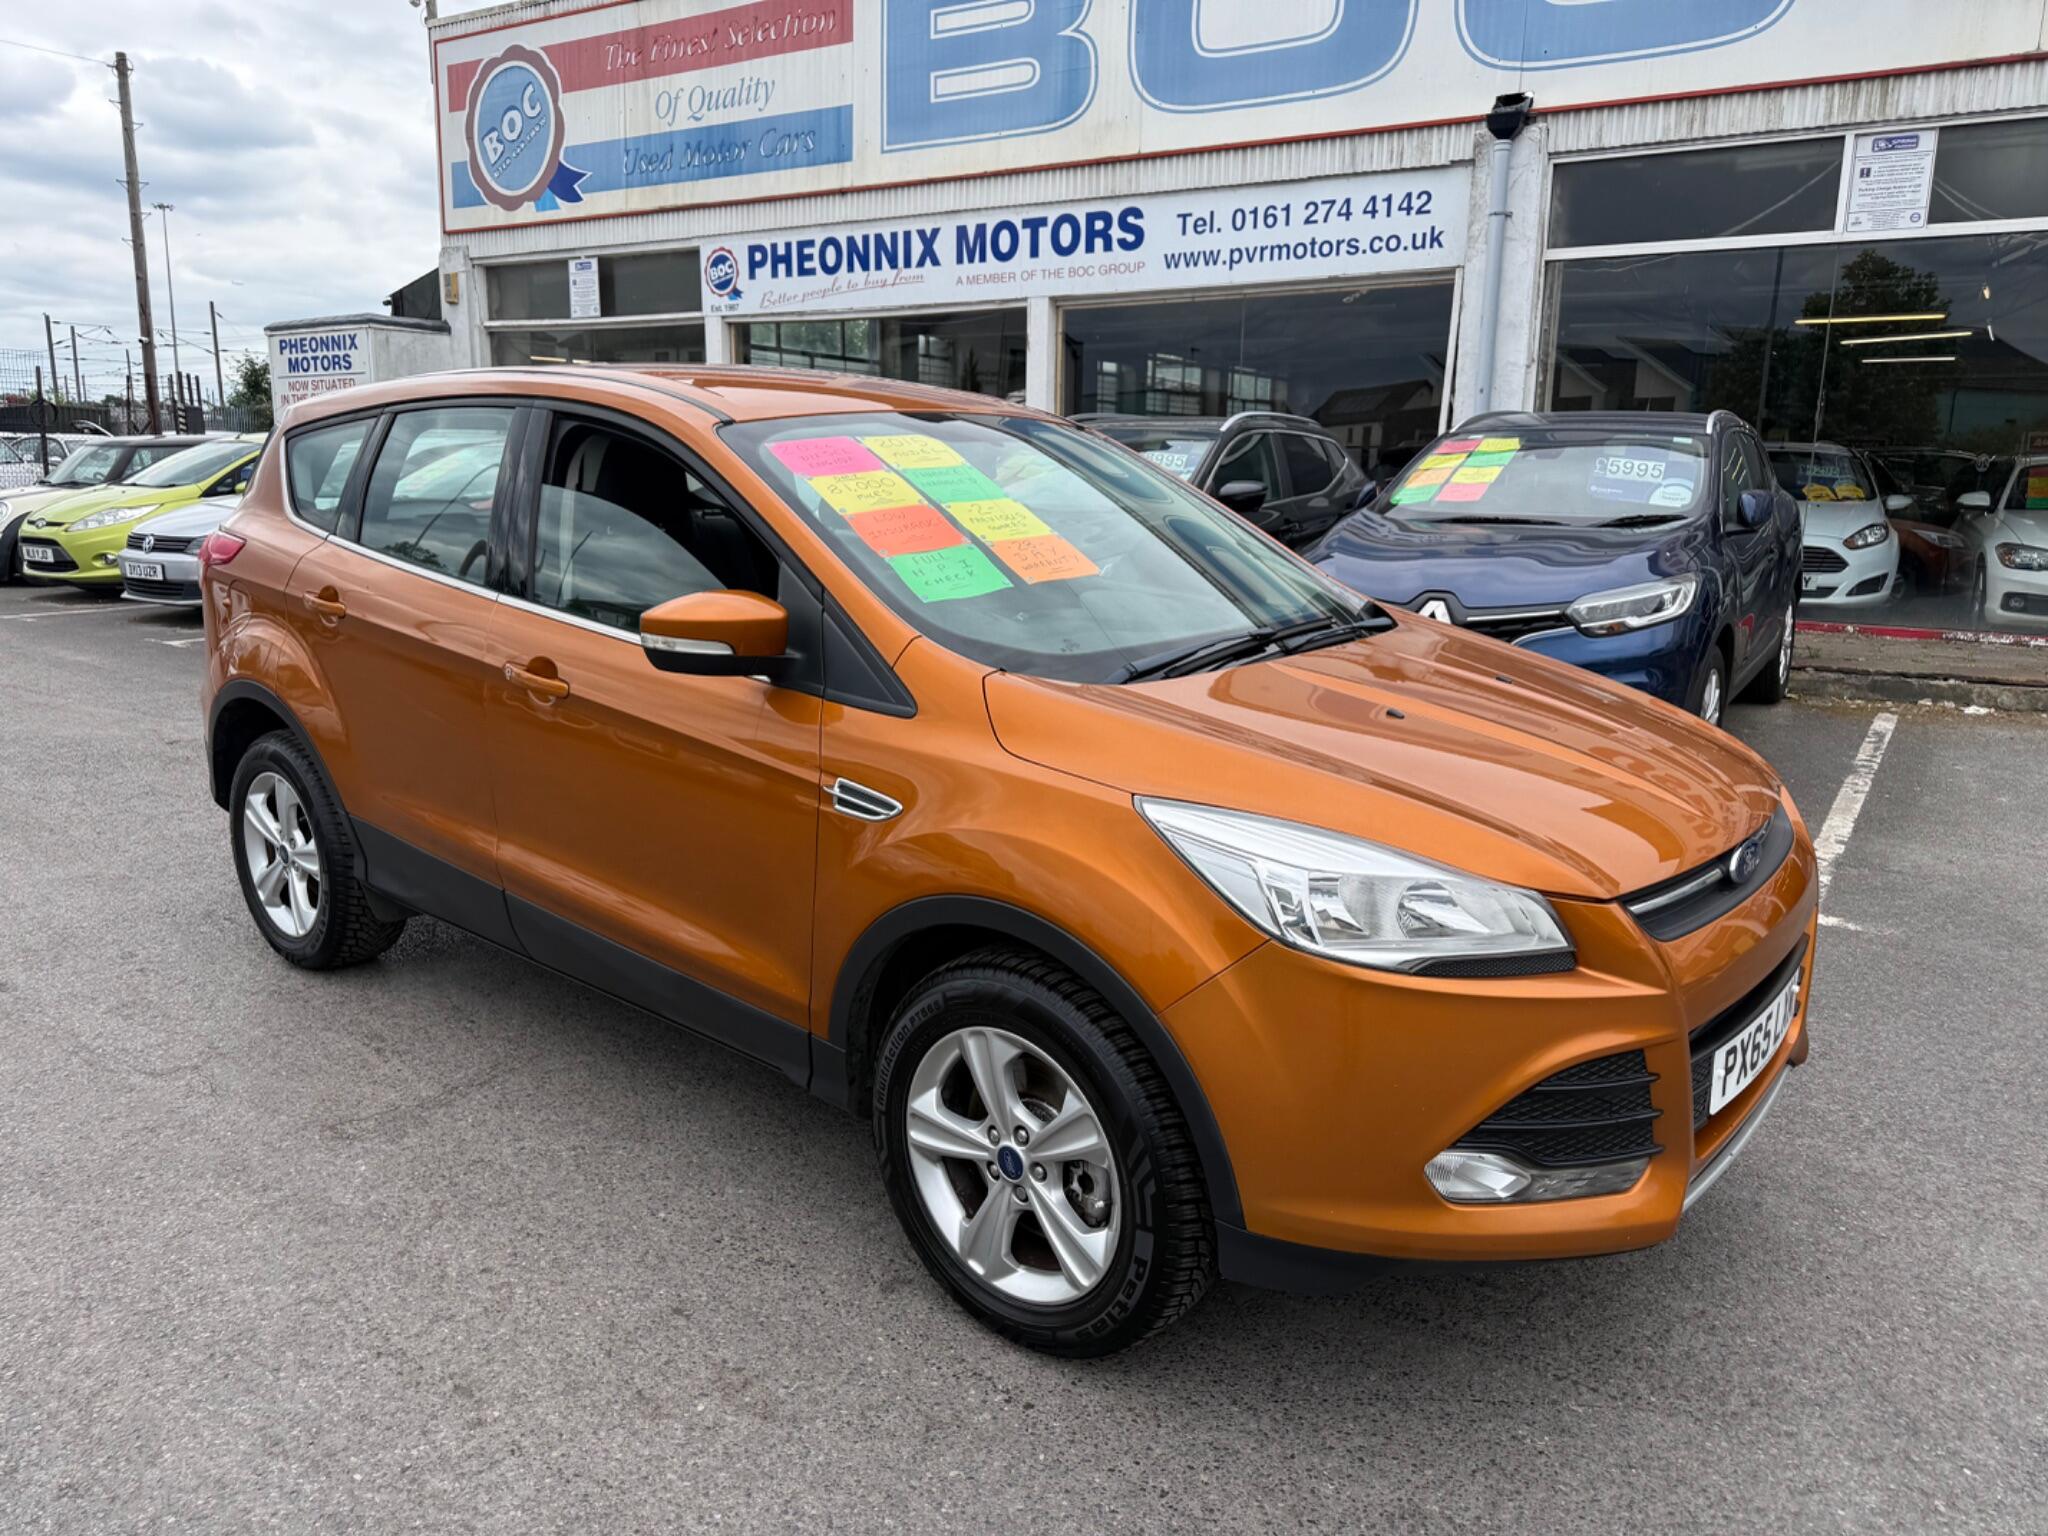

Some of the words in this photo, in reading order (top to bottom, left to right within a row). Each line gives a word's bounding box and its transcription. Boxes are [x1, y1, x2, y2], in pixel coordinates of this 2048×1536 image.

[605, 42, 643, 71] The
[650, 27, 719, 63] Finest
[725, 8, 838, 51] Selection
[481, 81, 543, 166] BOC
[655, 87, 684, 126] Of
[688, 76, 776, 122] Quality
[623, 144, 674, 176] Used
[678, 137, 752, 170] Motor
[759, 126, 817, 158] Cars
[1176, 210, 1222, 236] Tel.
[1231, 203, 1291, 232] 0161
[1303, 197, 1352, 225] 274
[1363, 190, 1432, 219] 4142
[747, 227, 941, 280] PHEONNIX
[956, 206, 1145, 265] MOTORS
[1163, 225, 1445, 270] www.pvrmotors.co.uk
[710, 260, 733, 280] BOC
[760, 290, 799, 309] Better
[802, 277, 842, 301] people
[847, 280, 858, 290] to
[864, 271, 887, 287] buy
[892, 267, 924, 287] from
[956, 277, 964, 286] A
[966, 271, 1017, 285] MEMBER
[1021, 270, 1037, 281] OF
[1042, 268, 1064, 280] THE
[1068, 265, 1095, 277] BOC
[1099, 262, 1145, 276] GROUP
[279, 333, 358, 355] PHEONNIX
[287, 353, 352, 373] MOTORS
[288, 380, 309, 392] NOW
[311, 378, 355, 391] SITUATED
[924, 569, 975, 587] CHECK
[1722, 1010, 1773, 1098] PX65
